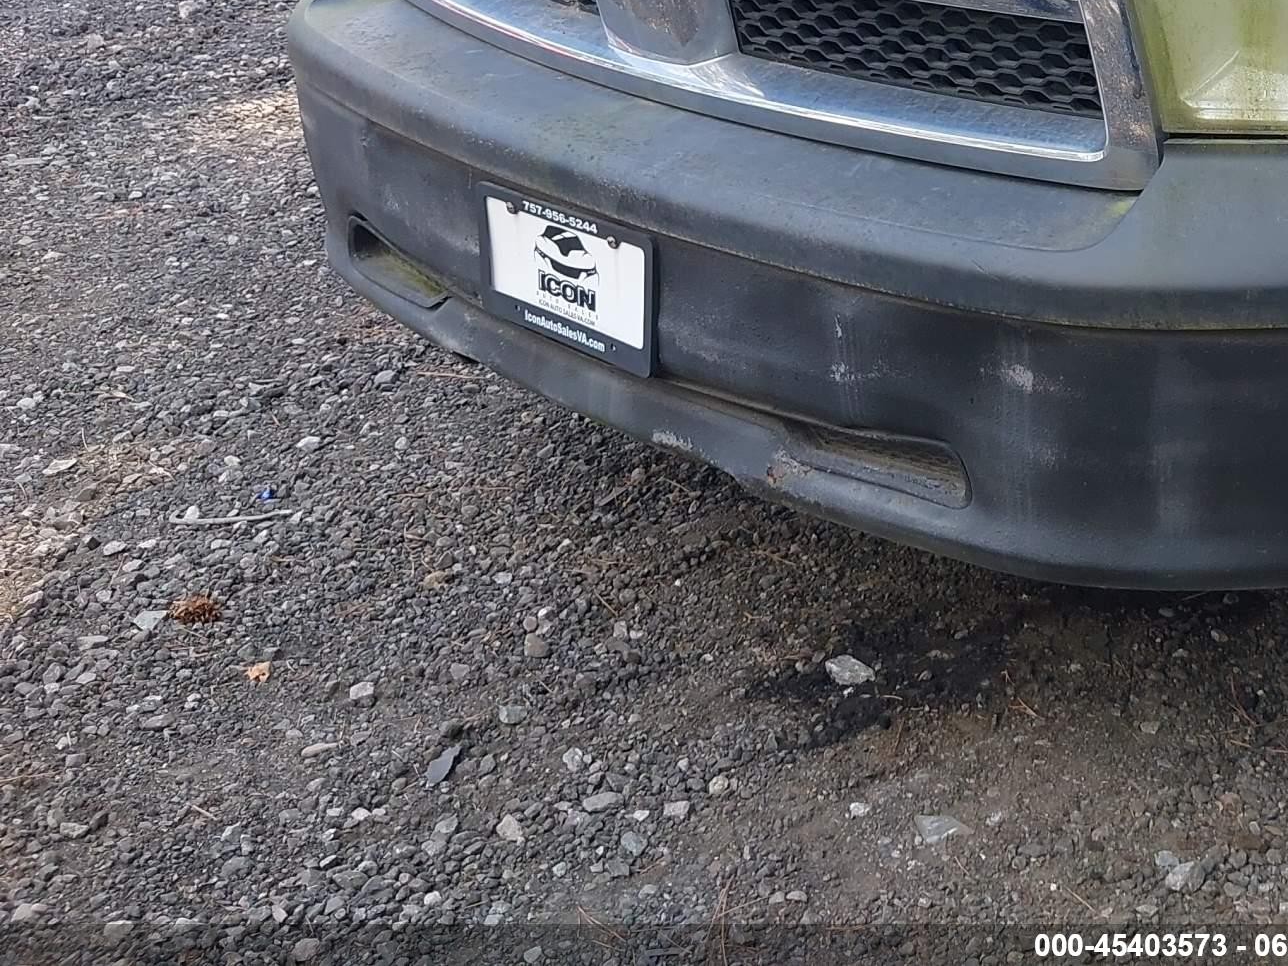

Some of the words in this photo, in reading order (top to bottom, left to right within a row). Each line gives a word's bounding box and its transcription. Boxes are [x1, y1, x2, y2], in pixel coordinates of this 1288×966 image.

[522, 201, 598, 234] 757-956-5244
[537, 268, 597, 313] ICON
[524, 309, 606, 353] IconAutoSalesVA.com
